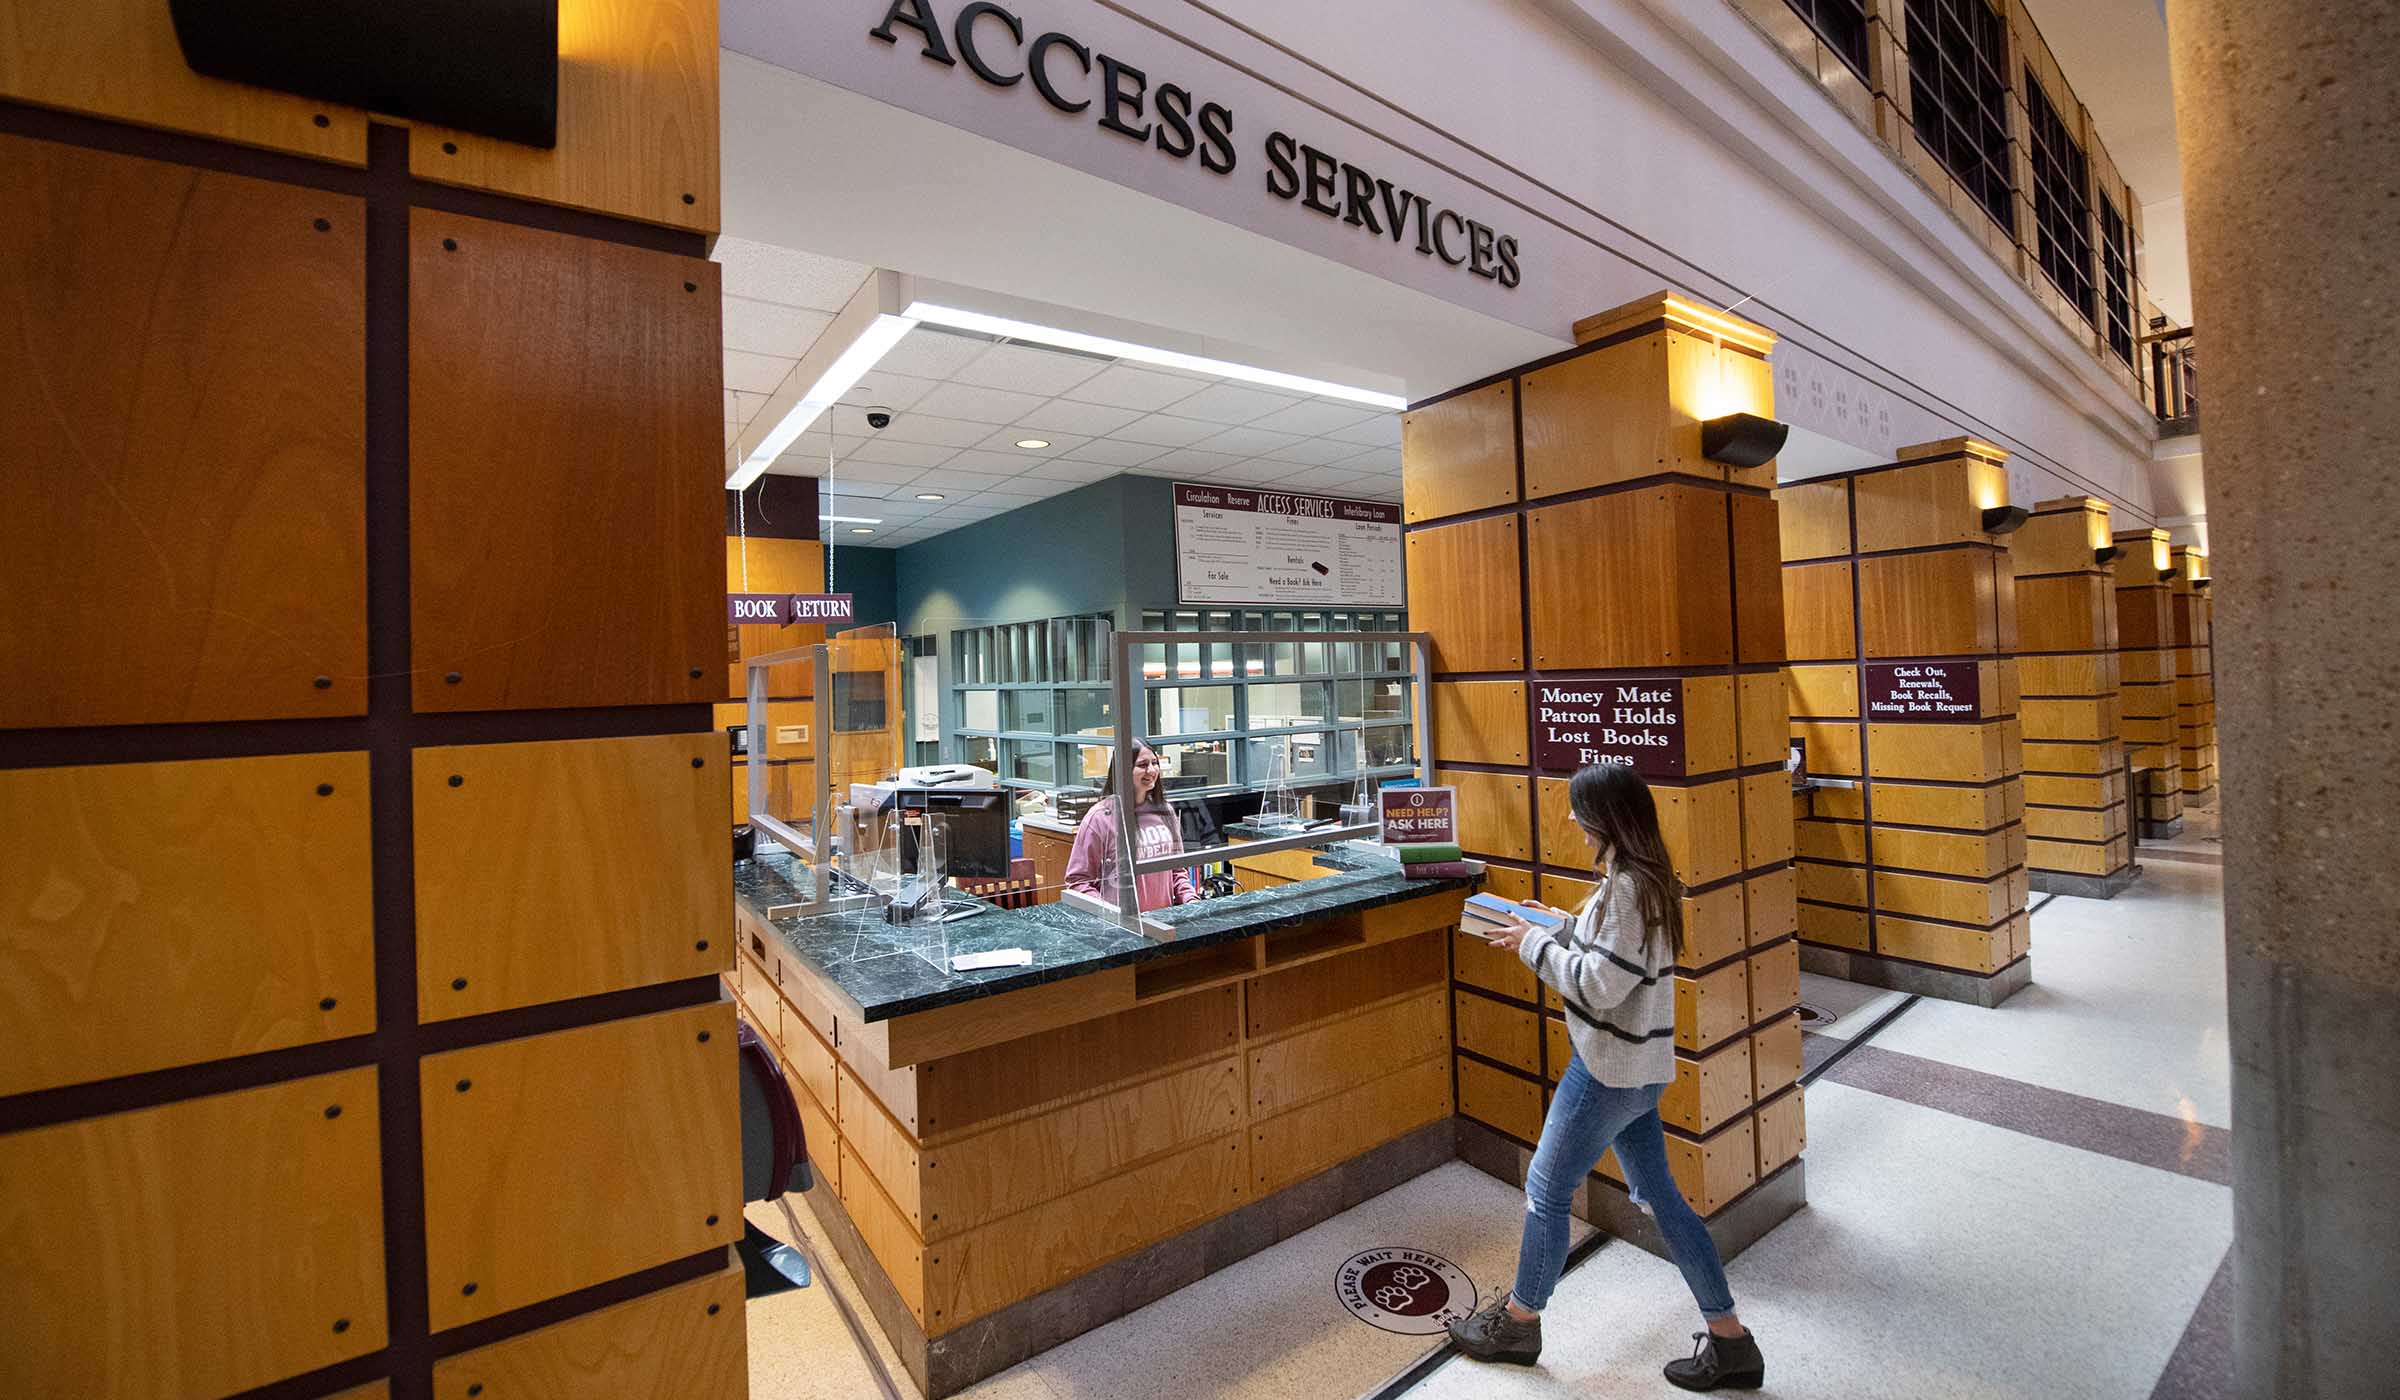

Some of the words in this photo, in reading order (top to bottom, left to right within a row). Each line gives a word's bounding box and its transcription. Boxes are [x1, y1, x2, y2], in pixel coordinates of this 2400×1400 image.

[871, 0, 1236, 175] ACCESS
[1265, 131, 1521, 288] SERVICES
[1186, 490, 1220, 504] Circulation
[1227, 493, 1250, 506] Reserve
[1257, 494, 1290, 515] ACCESS
[1294, 497, 1334, 519] SERVICES
[1343, 505, 1372, 520] Interlibrary
[1373, 508, 1385, 519] Loan
[1203, 509, 1223, 519] Services
[1208, 570, 1217, 580] For
[1217, 571, 1229, 580] Sale
[1269, 576, 1281, 585] Need
[734, 600, 777, 618] BOOK
[1894, 667, 1921, 678] Check
[1925, 666, 1947, 678] Out,
[1899, 679, 1943, 689] Renewals,
[1541, 687, 1604, 707] Money
[1890, 690, 1913, 700] Book
[1917, 689, 1953, 701] Recalls,
[1871, 701, 1904, 714] Missing
[1908, 701, 1932, 712] Book
[1936, 701, 1973, 714] Request
[1540, 707, 1602, 724] Patron
[1613, 707, 1677, 725] Holds
[1548, 727, 1591, 744] Lost
[1602, 728, 1668, 747] Books
[1579, 748, 1634, 766] Fines
[1386, 808, 1415, 818] NEED
[1417, 807, 1449, 817] HELP?
[1387, 818, 1415, 830] ASK
[1418, 818, 1449, 829] HERE
[1343, 1267, 1368, 1310] PLEASE
[1356, 1251, 1393, 1267] WAIT
[1402, 1251, 1446, 1271] HERE
